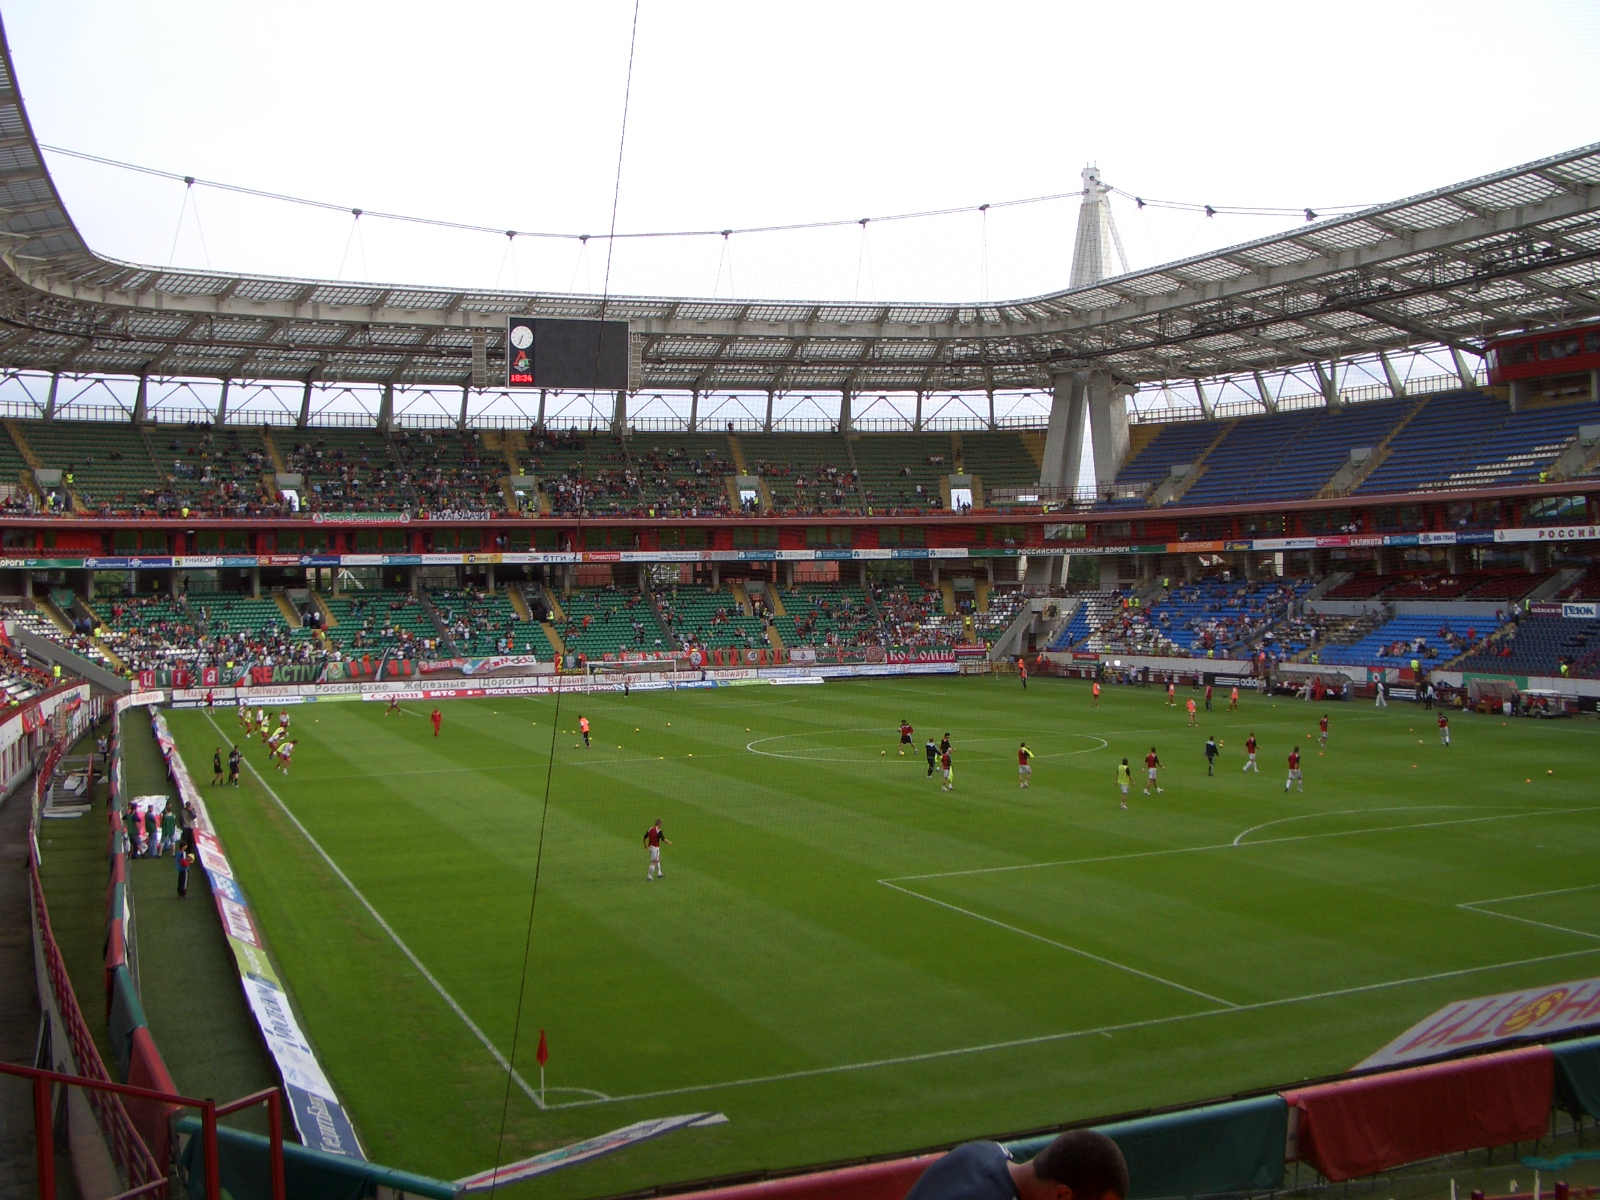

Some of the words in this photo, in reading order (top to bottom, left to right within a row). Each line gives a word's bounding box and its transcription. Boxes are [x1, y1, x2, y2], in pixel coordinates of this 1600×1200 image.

[510, 374, 533, 382] 18:34
[324, 513, 399, 524] Барабанщики
[1539, 526, 1600, 538] РОССИЙ
[142, 669, 231, 687] ultas
[548, 675, 586, 684] Russian
[605, 673, 642, 683] Railways
[660, 671, 696, 680] Russian
[714, 670, 749, 680] Railways
[315, 683, 389, 693] Российские
[404, 680, 466, 690] Железные
[483, 677, 525, 688] Дороги
[248, 686, 289, 696] Railways
[486, 687, 549, 696] РОСГОССТРАХ
